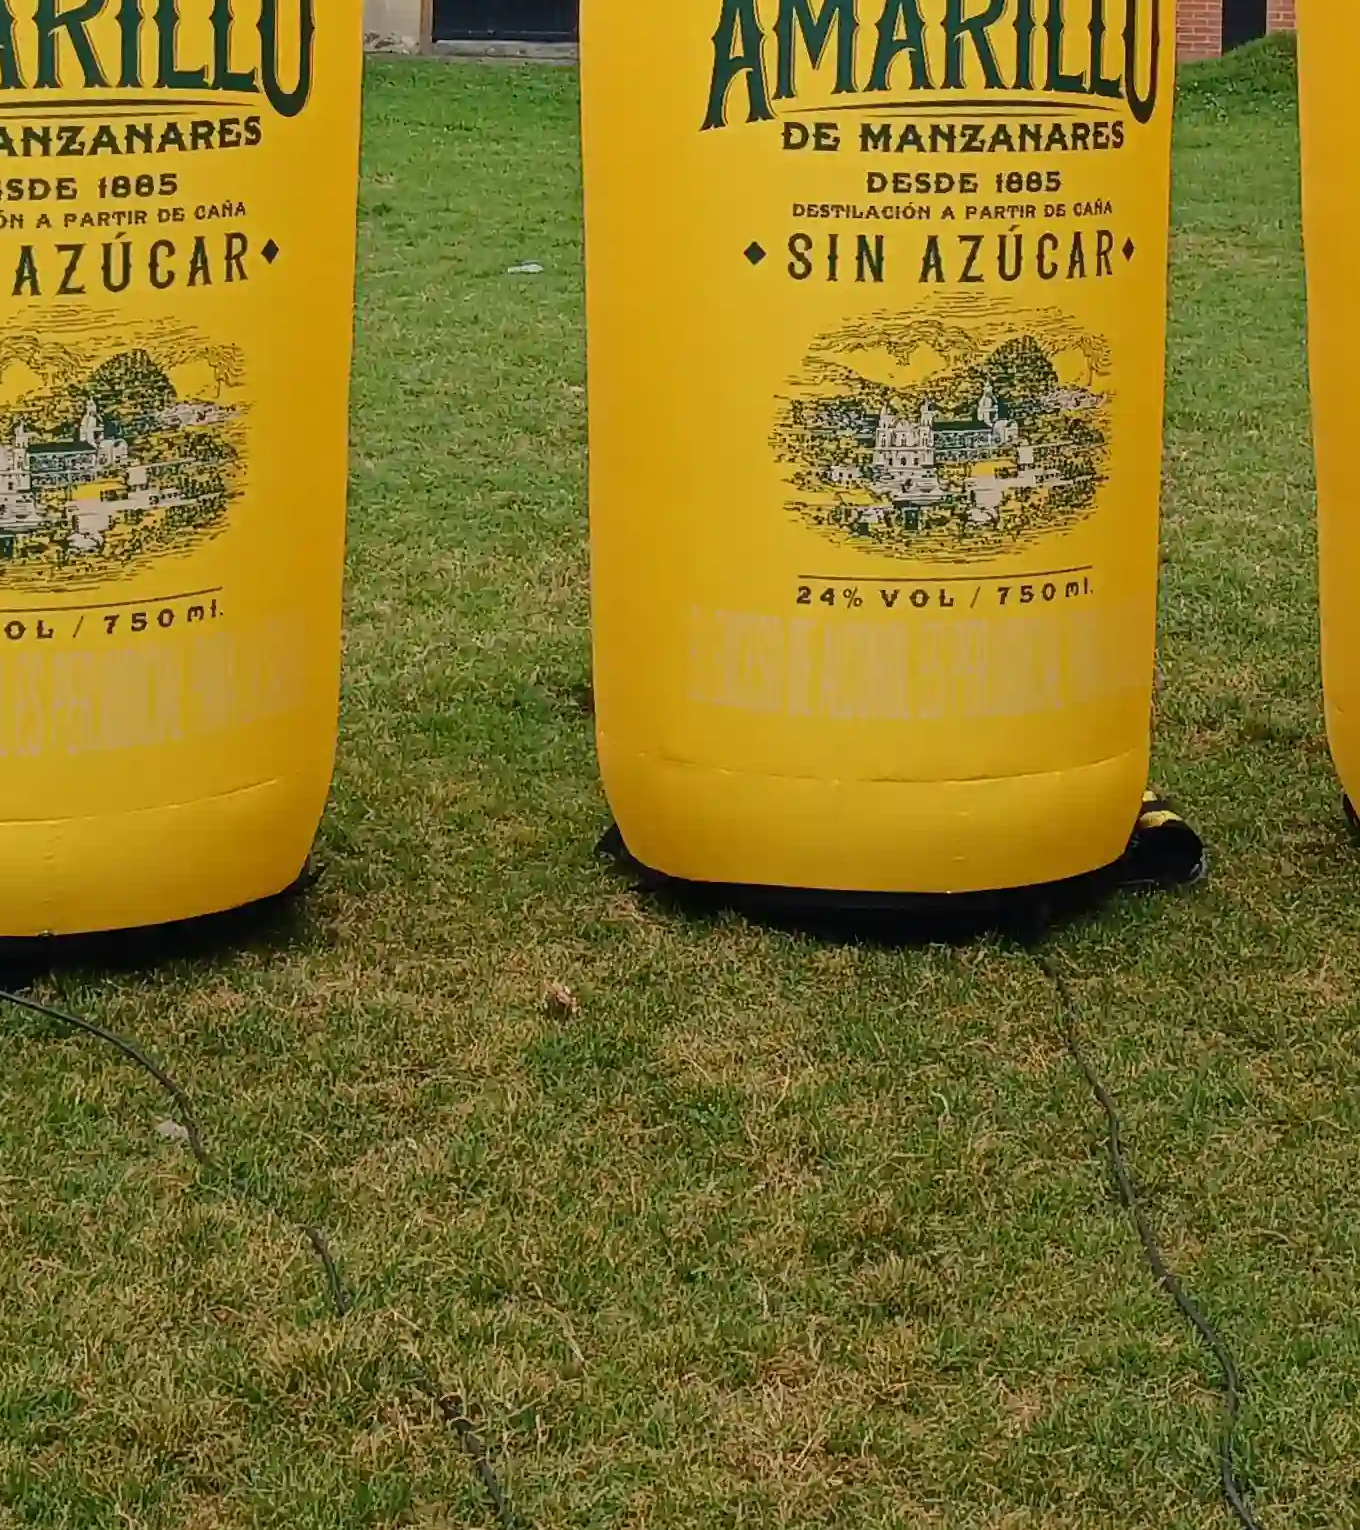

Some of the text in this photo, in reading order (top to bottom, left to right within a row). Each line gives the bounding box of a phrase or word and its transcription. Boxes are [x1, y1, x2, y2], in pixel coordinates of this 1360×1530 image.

[781, 119, 1125, 154] DE MANZANARES
[97, 172, 180, 199] 1885
[866, 170, 1063, 195] DESDE 1885
[35, 212, 52, 230] A
[63, 209, 149, 229] PARTIR
[156, 206, 186, 225] DE
[193, 199, 248, 222] CAÑA
[791, 197, 1114, 221] DESTILACIÓN A PARTIR DE CAÑA
[11, 231, 250, 297] AZÚCAR
[786, 224, 1116, 284] SIN AZÚCAR
[795, 584, 864, 609] 24%
[879, 588, 955, 609] VOL
